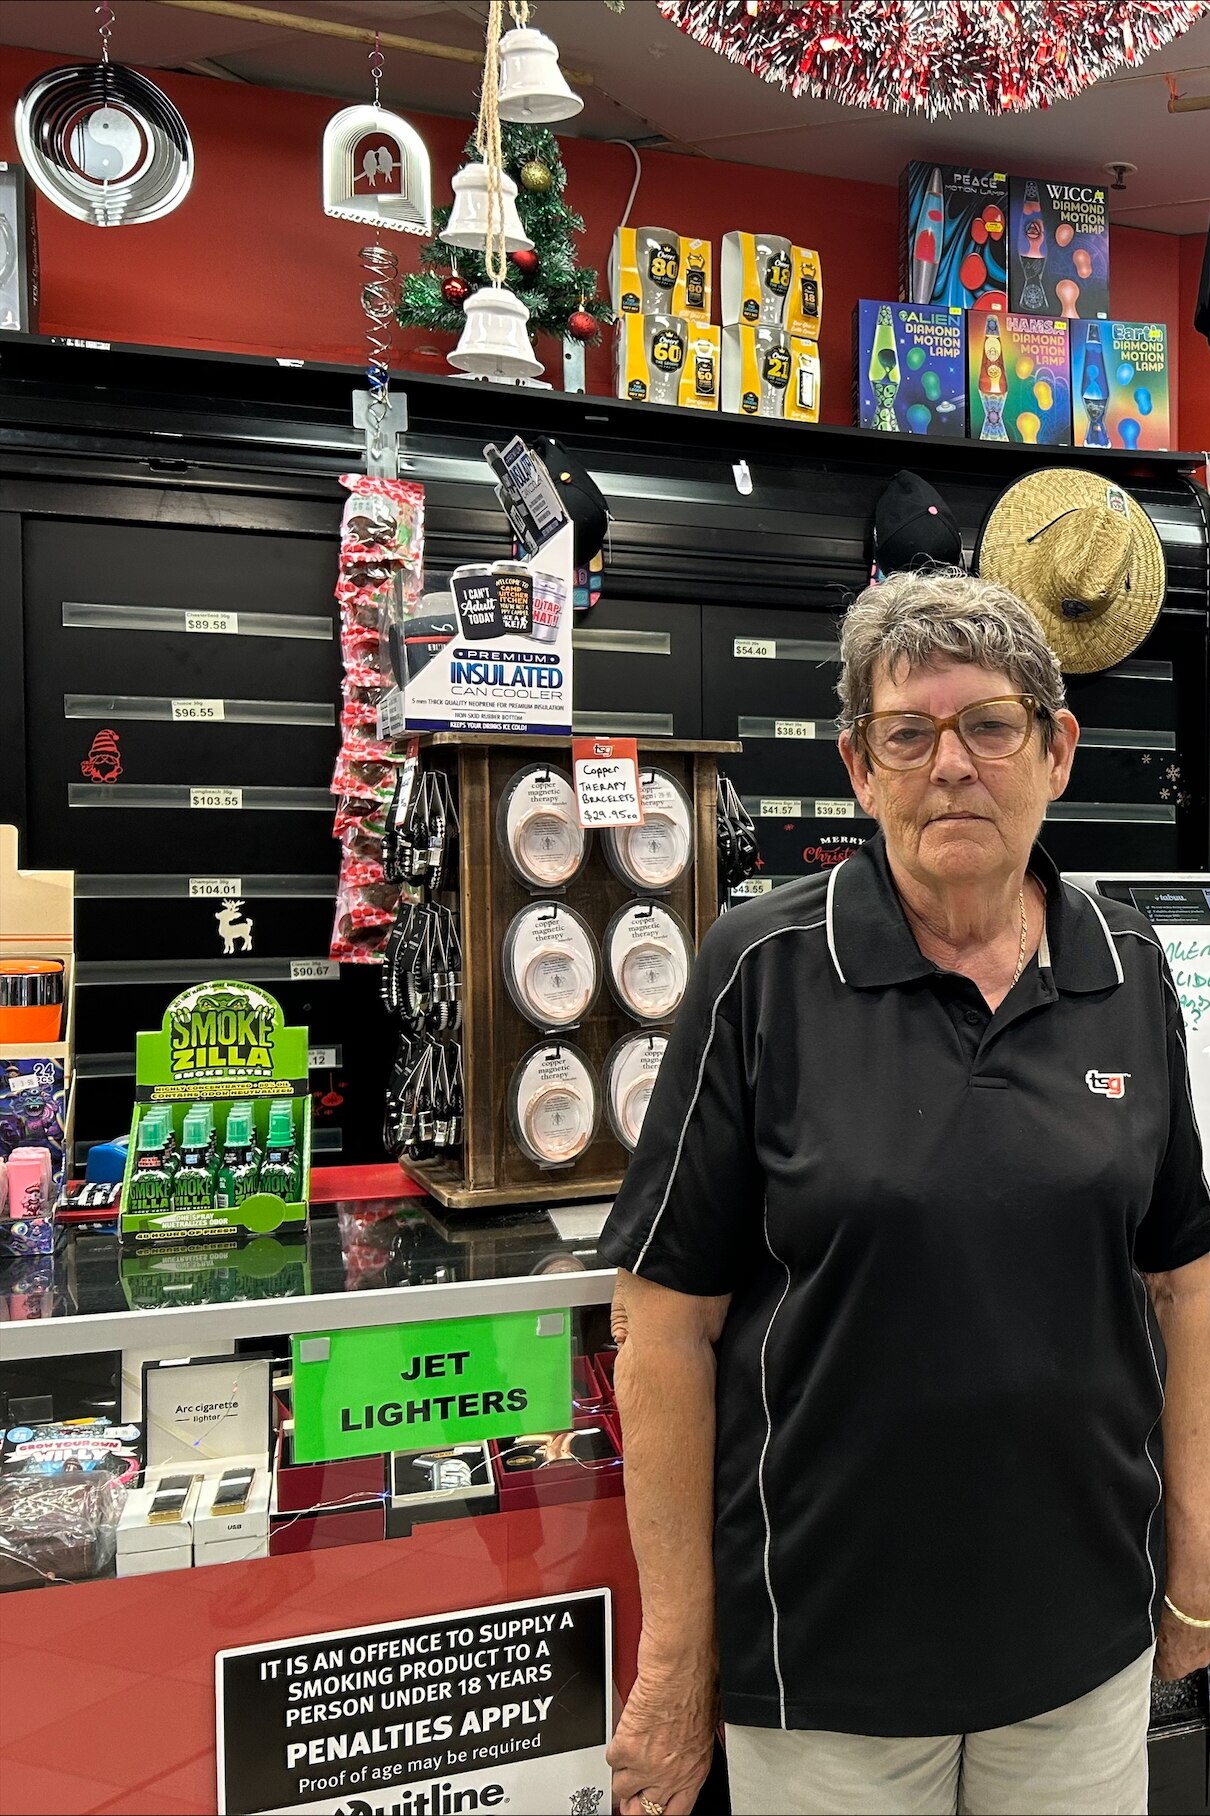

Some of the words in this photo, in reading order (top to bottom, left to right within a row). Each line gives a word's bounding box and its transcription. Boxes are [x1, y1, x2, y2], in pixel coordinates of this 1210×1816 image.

[953, 173, 998, 189] PEACE
[1046, 184, 1105, 204] WICCA
[1052, 200, 1105, 214] DIAMOND
[1060, 211, 1105, 225] MOTION
[1075, 222, 1105, 234] LAMP
[652, 257, 677, 279] 80
[907, 312, 960, 327] ALIEN
[905, 323, 960, 337] DIAMOND
[914, 334, 960, 348] MOTION
[1012, 333, 1065, 345] DIAMOND
[1021, 345, 1065, 356] MOTION
[1113, 340, 1164, 352] DIAMOND
[654, 343, 681, 362] 60
[929, 346, 960, 358] LAMP
[1121, 351, 1164, 362] MOTION
[1036, 356, 1065, 366] LAMP
[1136, 361, 1164, 372] LAMP
[768, 360, 788, 379] 21
[698, 371, 712, 380] 60
[469, 588, 489, 600] CAN'T
[460, 599, 497, 617] Adult
[468, 613, 495, 625] TODAY
[188, 620, 227, 630] $89.58
[736, 646, 767, 655] $54.40
[467, 650, 547, 664] PREMIUM
[450, 661, 564, 689] INSULATED
[451, 686, 488, 697] CAN
[492, 688, 564, 700] COOLER
[175, 708, 214, 718] $96.55
[777, 727, 807, 736] $38.61
[583, 765, 619, 777] Copper
[531, 782, 556, 790] copper
[579, 781, 627, 791] THERAPY
[527, 788, 561, 796] magnetic
[193, 796, 238, 806] $103.55
[530, 795, 559, 803] therapy
[582, 793, 636, 804] BRACELETS
[762, 806, 793, 815] $41.57
[817, 806, 847, 815] $39.59
[820, 836, 866, 845] MERRY
[803, 846, 857, 868] Christ
[192, 885, 236, 895] $104.01
[733, 885, 764, 893] $43.55
[534, 920, 559, 929] copper
[631, 917, 655, 926] copper
[532, 926, 565, 935] magnetic
[628, 923, 660, 932] magnetic
[535, 932, 564, 942] therapy
[631, 930, 659, 939] therapy
[293, 966, 329, 977] $90.67
[173, 1010, 274, 1049] SMOKE
[173, 1047, 272, 1071] ZILLA
[541, 1058, 567, 1068] copper
[34, 1063, 55, 1078] 24
[174, 1070, 223, 1080] SMOKE
[538, 1065, 571, 1074] magnetic
[540, 1072, 568, 1081] therapy
[1088, 1070, 1127, 1097] tsg
[131, 1198, 169, 1209] ZILLA
[150, 1230, 186, 1239] HOURS
[400, 1351, 471, 1381] JET
[175, 1404, 194, 1414] Arc
[195, 1400, 239, 1414] cigarette
[340, 1388, 528, 1433] LIGHTERS
[193, 1413, 220, 1423] lighter
[19, 1442, 53, 1451] GROW
[55, 1440, 90, 1448] YOUR
[91, 1441, 119, 1449] OWN
[33, 1448, 110, 1461] WILLY
[260, 1659, 282, 1681] IT
[286, 1655, 308, 1676] IS
[312, 1651, 344, 1672] AN
[350, 1631, 442, 1665] OFFENCE
[446, 1627, 475, 1649] TO
[478, 1614, 556, 1644] SUPPLY
[559, 1611, 575, 1629] A
[287, 1666, 394, 1703] SMOKING
[399, 1649, 499, 1683] PRODUCT
[503, 1644, 532, 1665] TO
[534, 1639, 551, 1658] A
[286, 1695, 374, 1728] PERSON
[380, 1681, 453, 1712] UNDER
[457, 1677, 482, 1697] 18
[486, 1663, 553, 1692] YEARS
[286, 1716, 454, 1769] PENALTIES
[460, 1696, 555, 1737] APPLY
[299, 1768, 346, 1794] Proof
[350, 1764, 368, 1783] of
[371, 1763, 403, 1782] age
[407, 1756, 441, 1777] may
[447, 1748, 467, 1766] be
[471, 1733, 542, 1761] required
